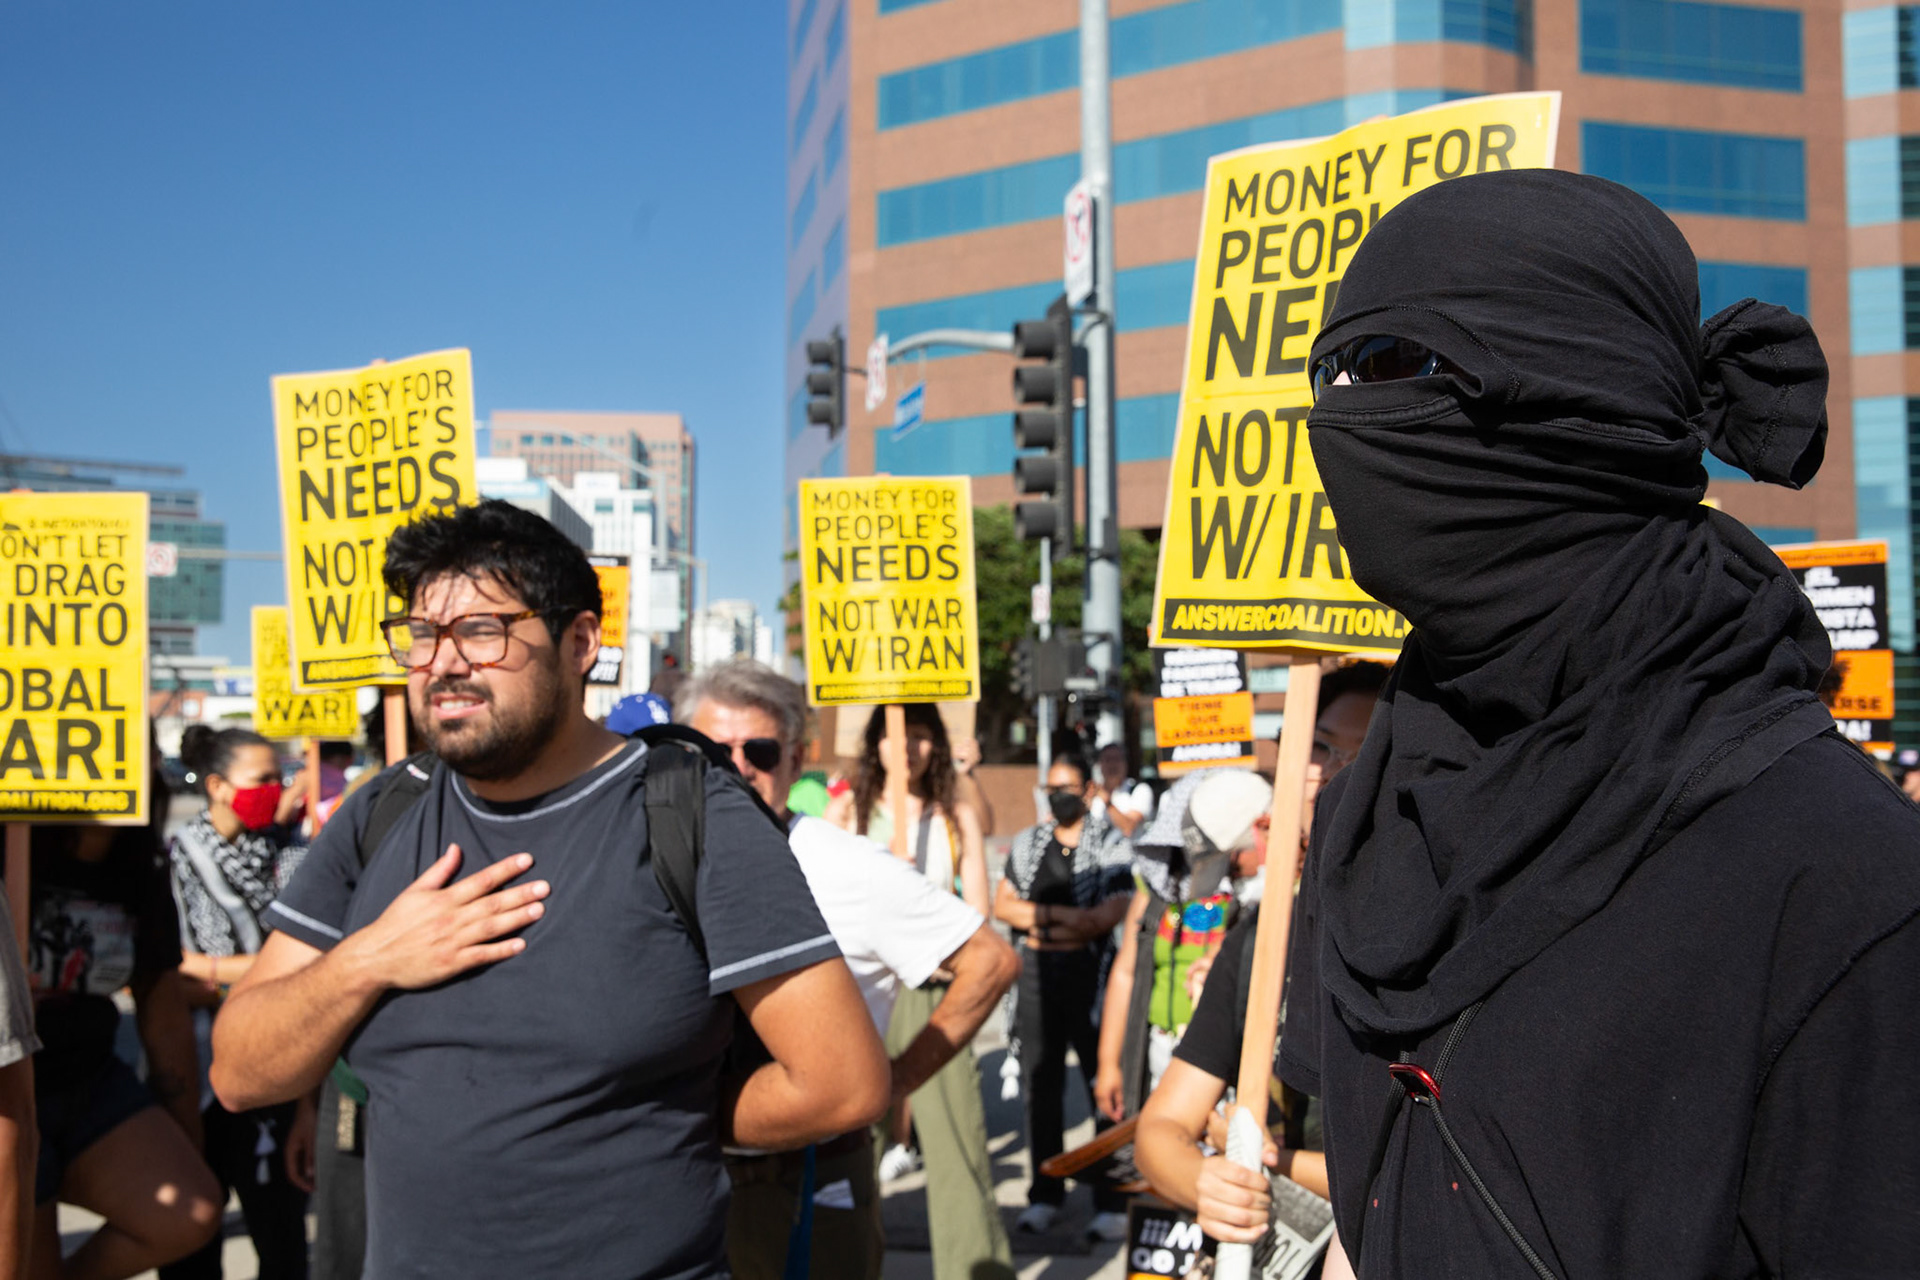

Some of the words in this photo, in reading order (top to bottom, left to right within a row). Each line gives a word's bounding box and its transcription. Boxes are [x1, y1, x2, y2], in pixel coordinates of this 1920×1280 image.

[1224, 143, 1387, 223] MONEY
[1402, 124, 1517, 187] FOR
[295, 381, 395, 419] MONEY
[404, 369, 454, 405] FOR
[297, 406, 456, 462] PEOPLE'S
[1191, 405, 1312, 488] NOT
[299, 450, 460, 522] NEEDS
[813, 489, 901, 511] MONEY
[911, 489, 956, 509] FOR
[1, 534, 66, 559] ON'T
[80, 534, 128, 558] LET
[814, 514, 957, 541] PEOPLE'S
[1191, 492, 1352, 580] W/IR
[15, 563, 125, 597] DRAG
[303, 538, 374, 589] NOT
[816, 544, 959, 584] NEEDS
[7, 602, 128, 646] INTO
[819, 599, 880, 632] NOT
[890, 598, 962, 630] WAR
[262, 695, 351, 722] WAR!
[0, 718, 126, 780] AR!
